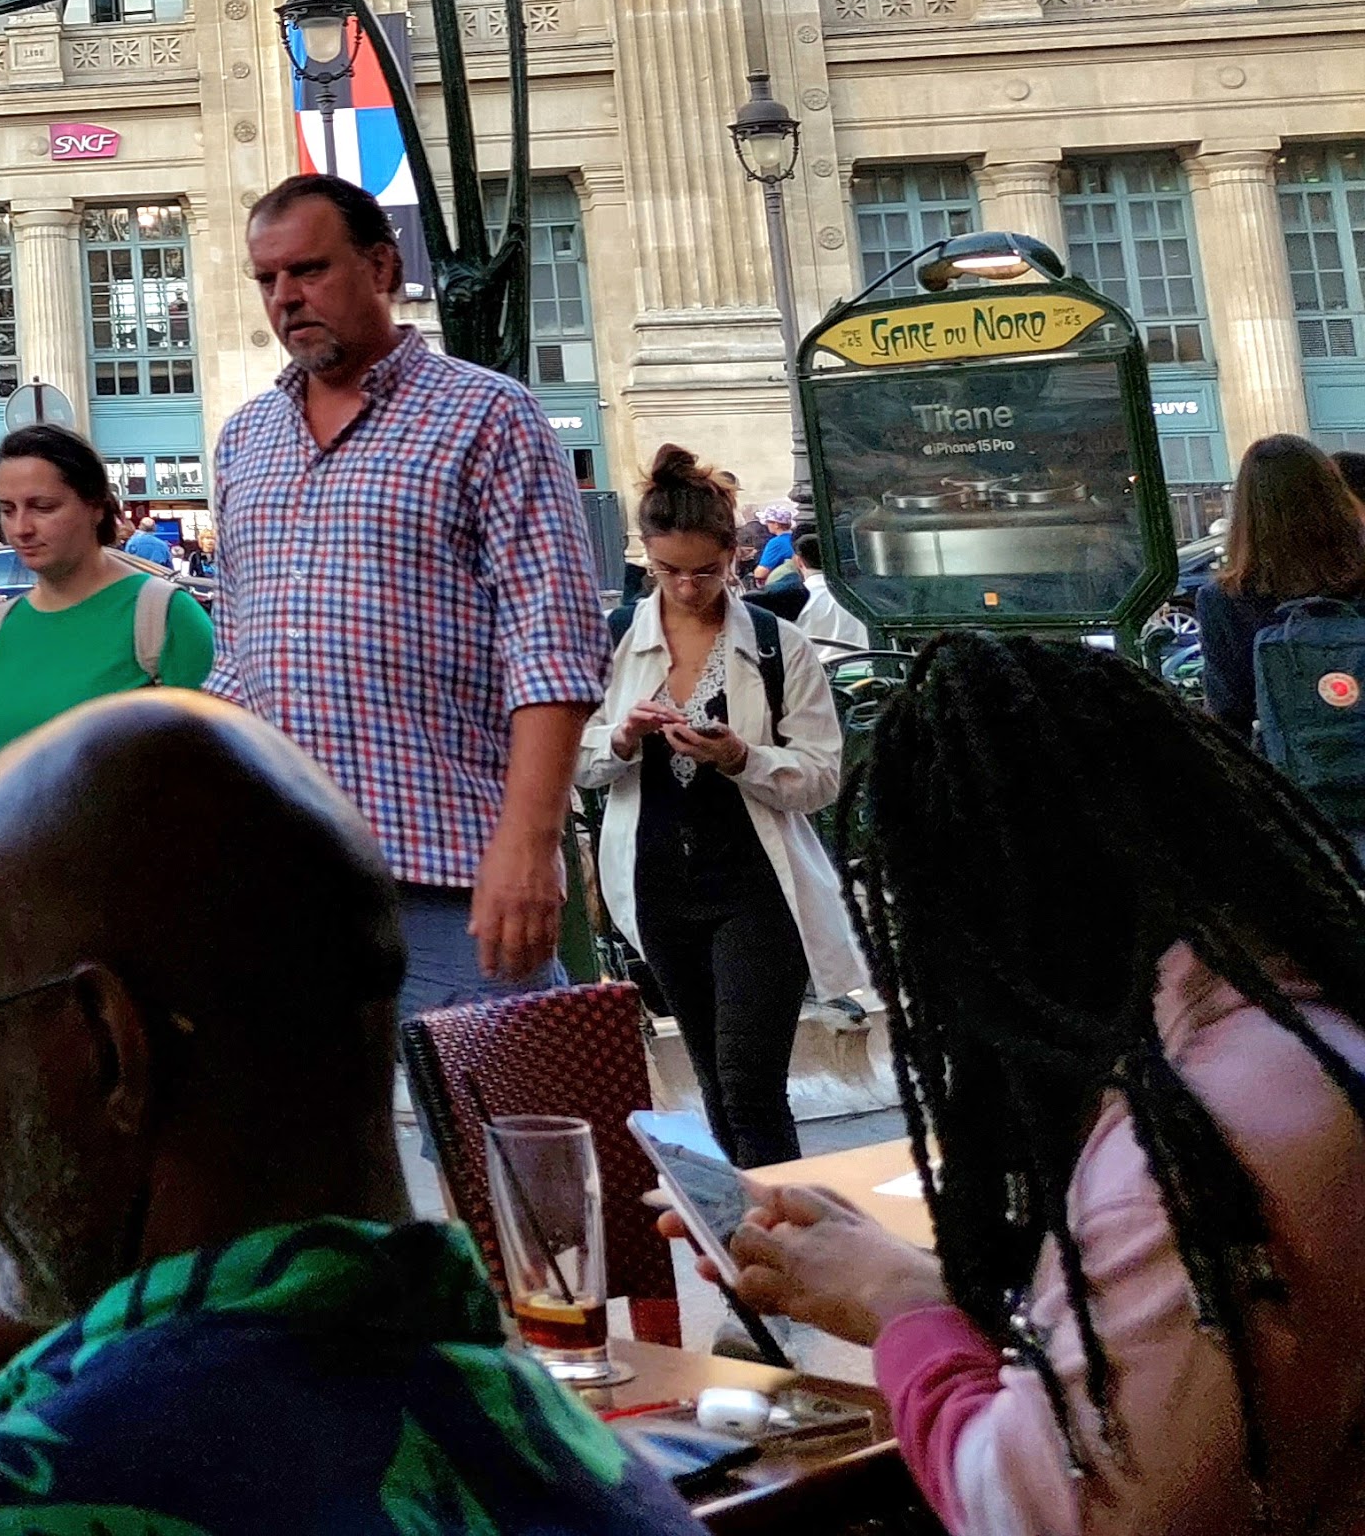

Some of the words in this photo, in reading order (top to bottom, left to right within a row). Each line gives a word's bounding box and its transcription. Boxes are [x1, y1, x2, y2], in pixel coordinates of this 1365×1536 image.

[53, 133, 116, 154] SNCF
[870, 317, 937, 357] GARE
[973, 305, 1047, 348] NORD
[911, 403, 1014, 434] Titane
[933, 439, 976, 454] iPhone
[977, 439, 991, 453] 15
[992, 438, 1015, 452] Pro
